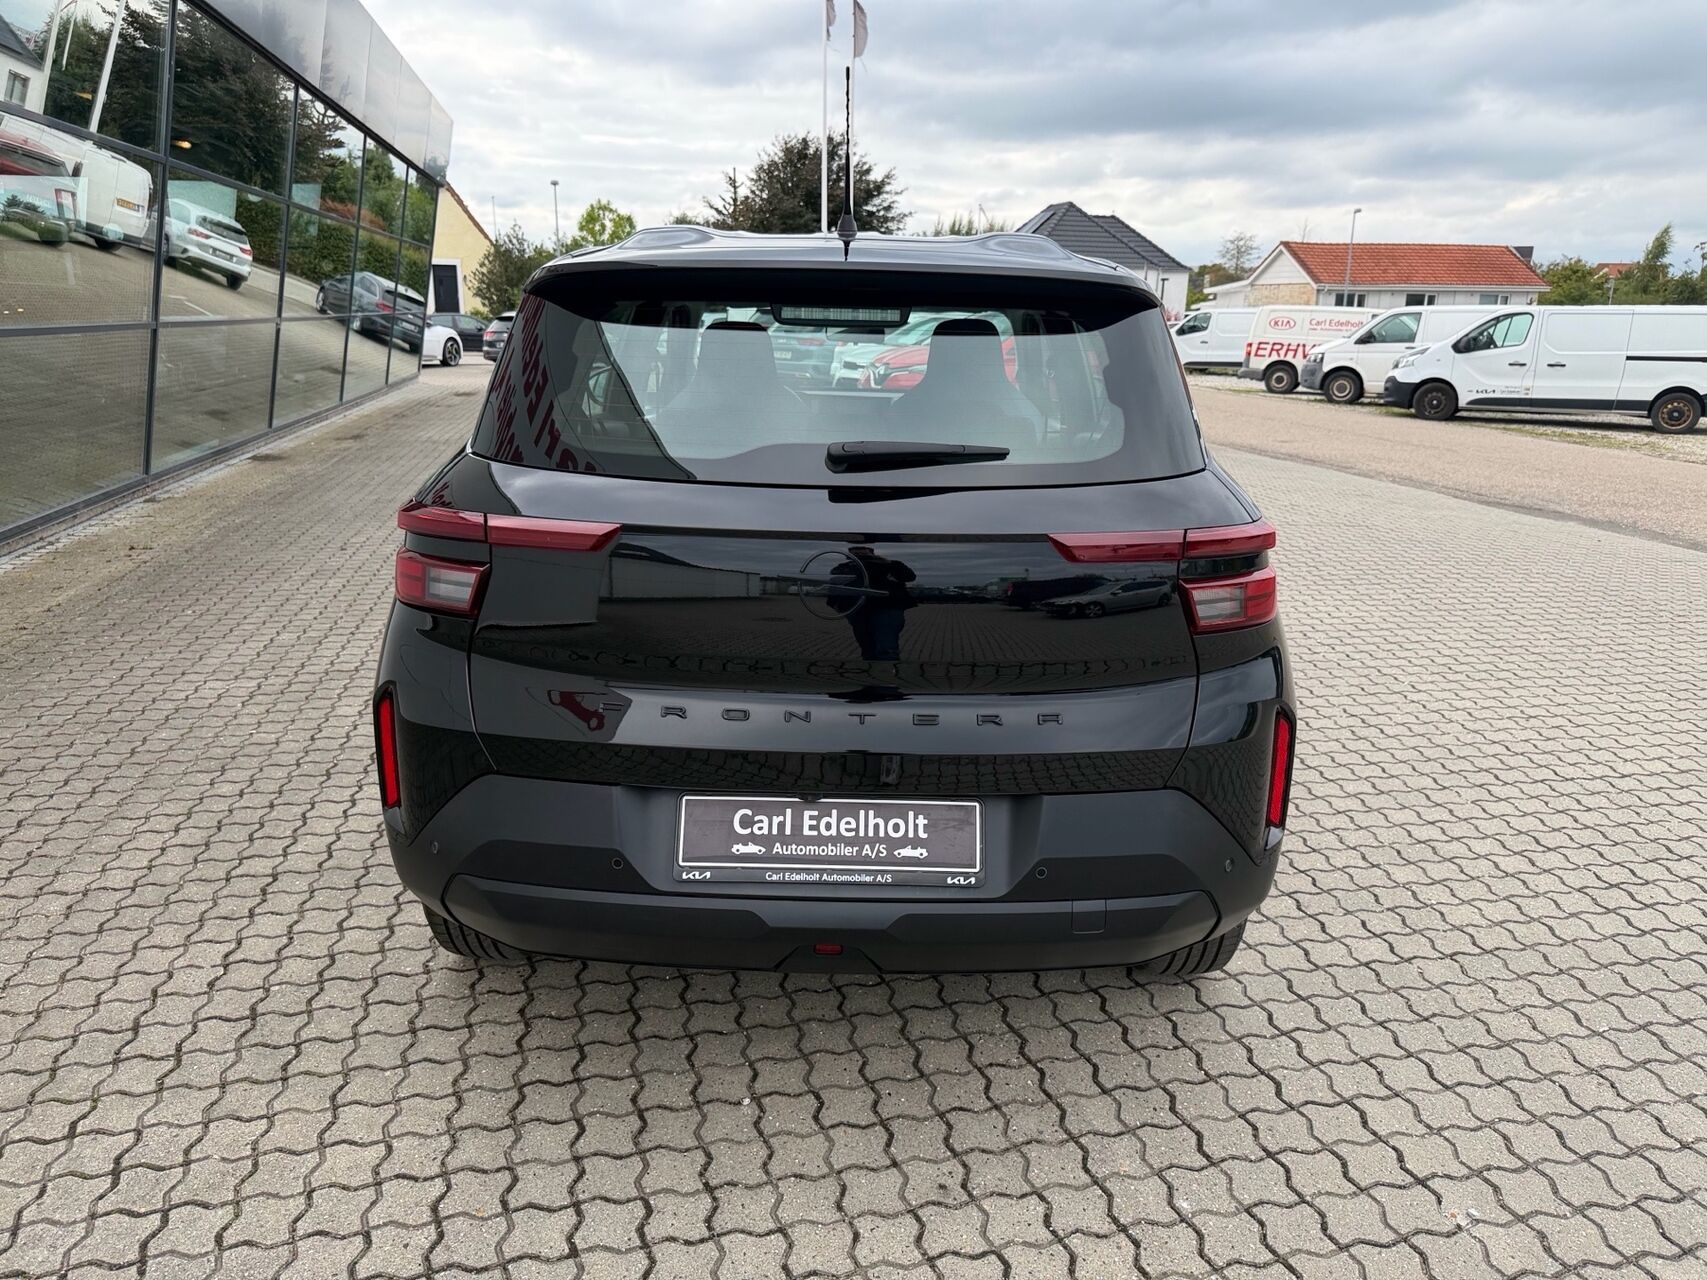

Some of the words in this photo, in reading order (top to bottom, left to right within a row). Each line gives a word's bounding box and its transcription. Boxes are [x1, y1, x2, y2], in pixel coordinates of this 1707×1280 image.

[1273, 319, 1292, 327] KIA
[1309, 318, 1327, 327] Carl
[1254, 342, 1321, 359] ERHV
[601, 702, 1063, 726] FRONTERA
[732, 808, 792, 836] Carl
[803, 809, 928, 839] Edelholt
[772, 842, 859, 857] Automobiler
[862, 844, 887, 858] A/S
[765, 871, 783, 881] Carl
[785, 871, 820, 882] Edelholt
[822, 872, 874, 883] Automobiler
[876, 873, 893, 883] A/S
